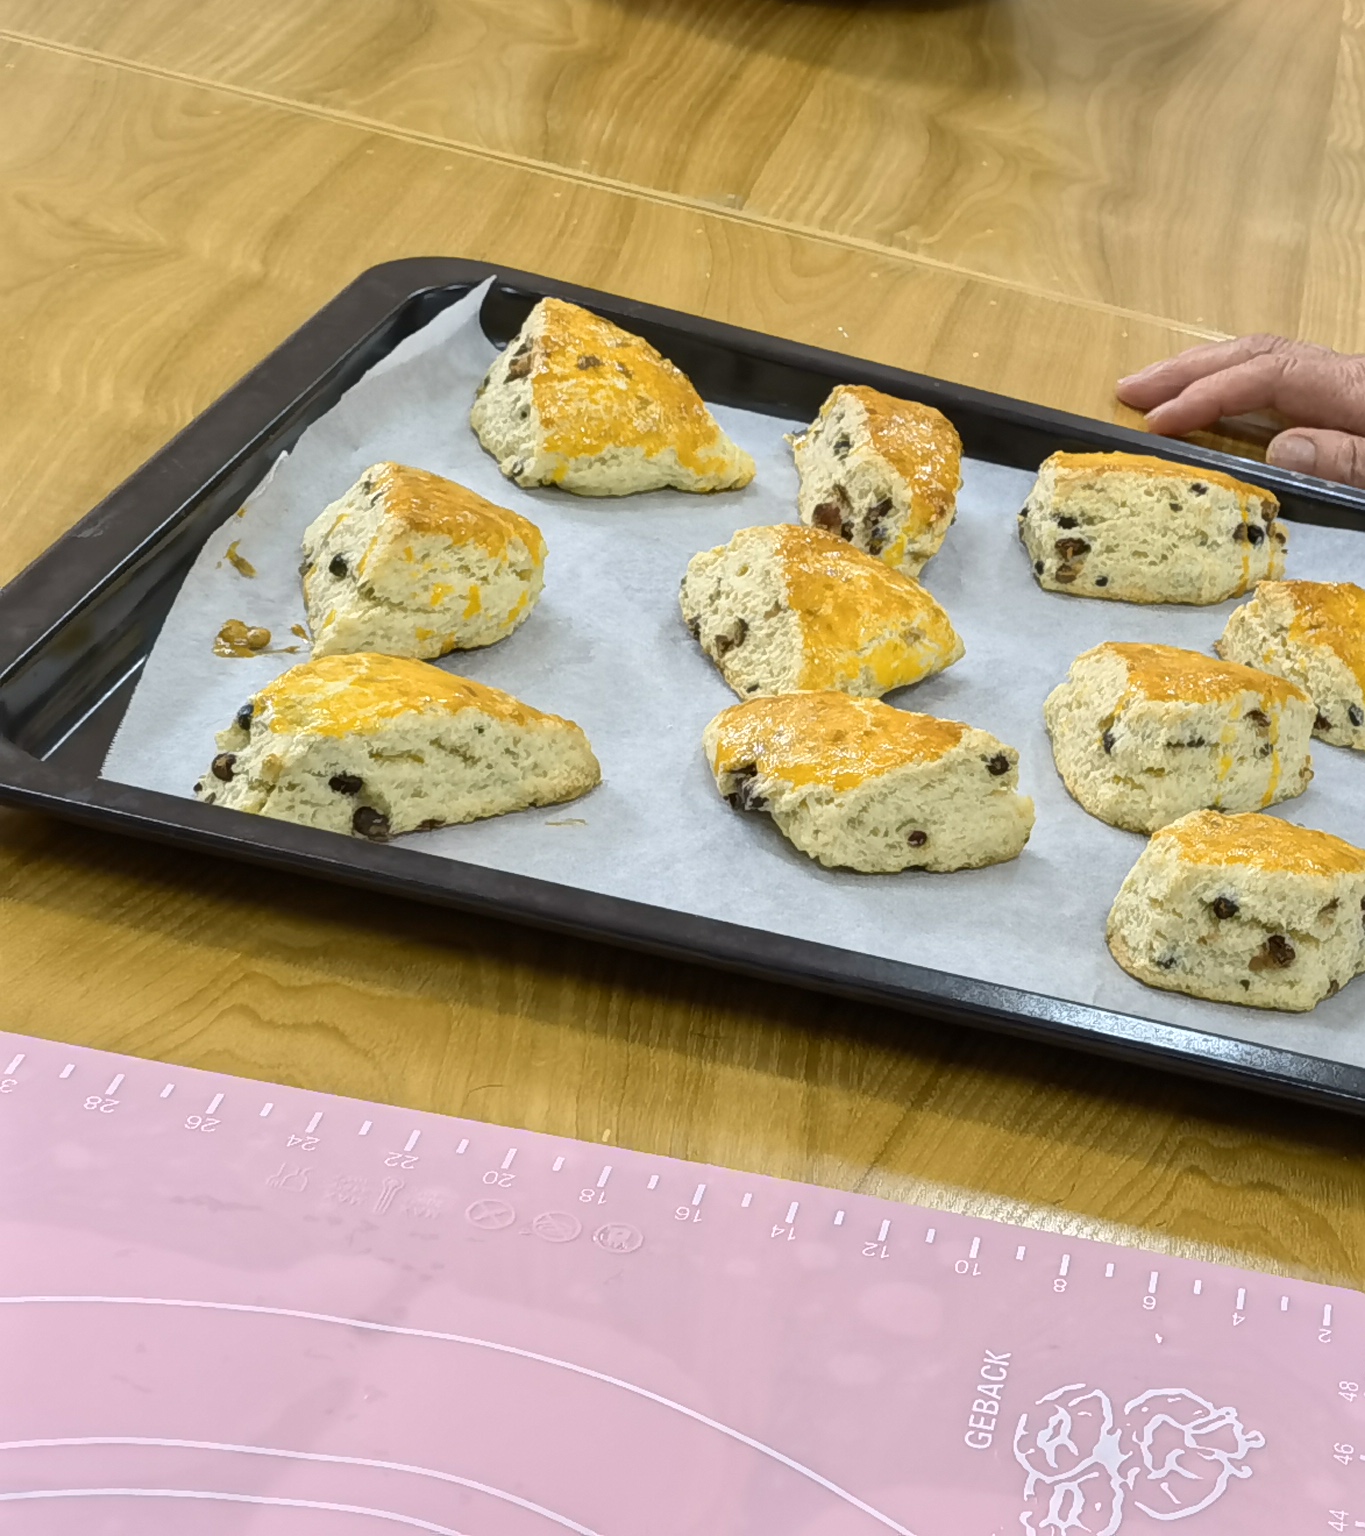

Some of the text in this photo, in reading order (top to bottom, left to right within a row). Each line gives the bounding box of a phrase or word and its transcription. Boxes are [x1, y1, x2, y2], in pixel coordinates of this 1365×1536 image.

[0, 1078, 1332, 1344] 2 4 6 8 10 12 14 16 18 20 22 24 26 28 3
[964, 1349, 1012, 1450] GEBACK
[1327, 1380, 1359, 1533] 44 46 48
